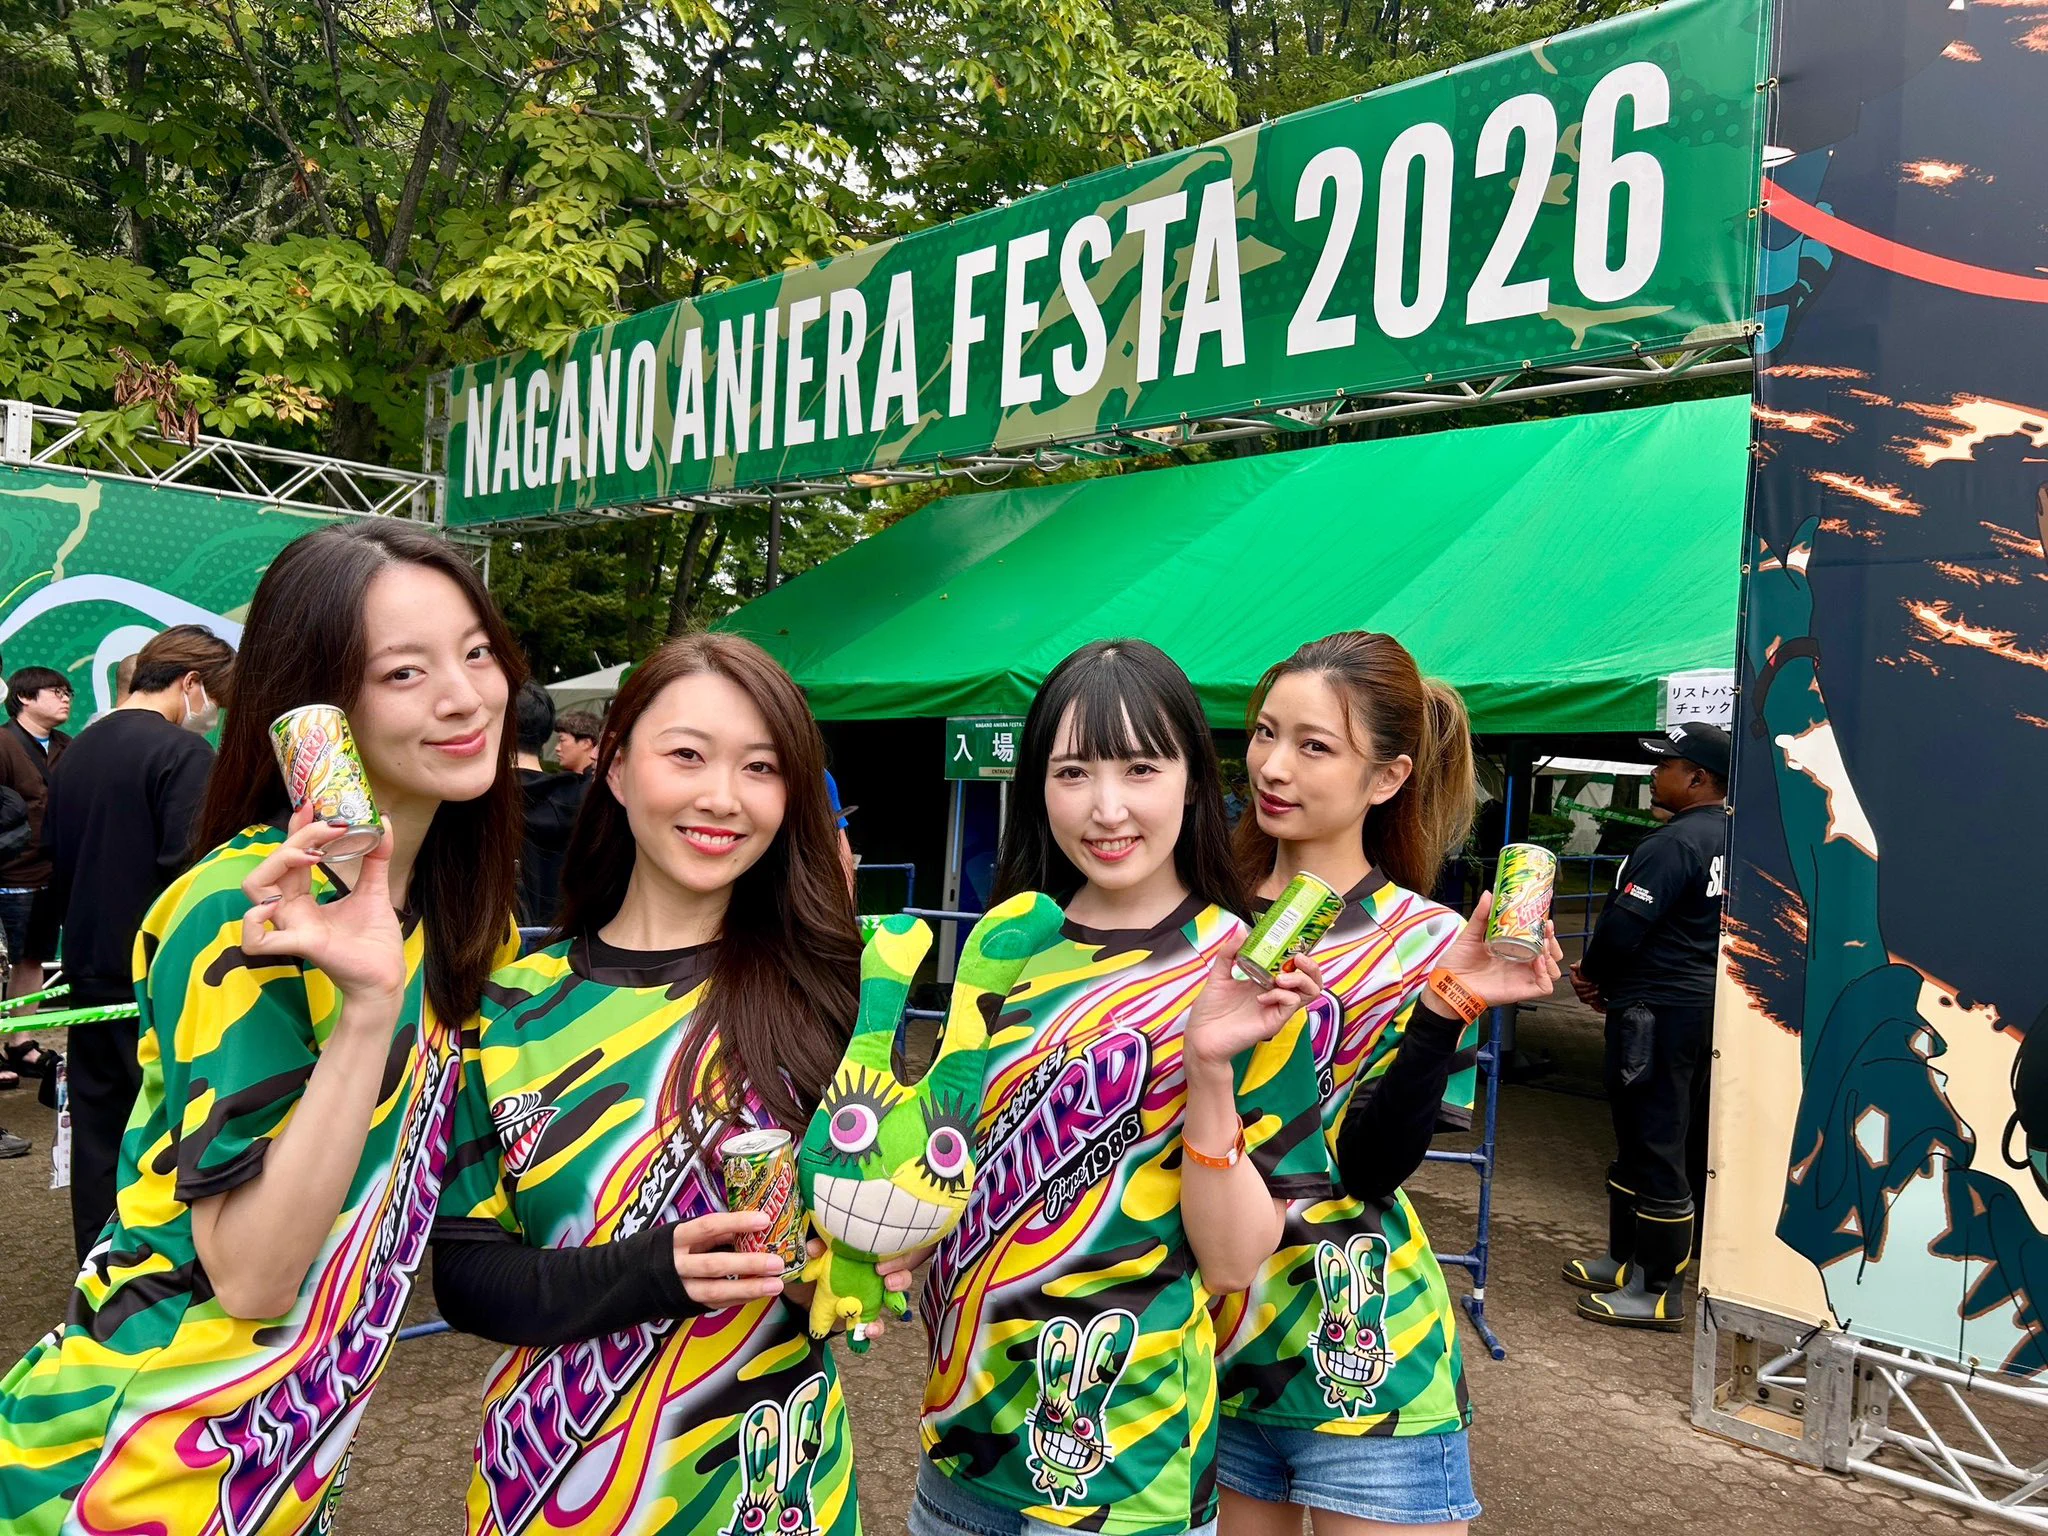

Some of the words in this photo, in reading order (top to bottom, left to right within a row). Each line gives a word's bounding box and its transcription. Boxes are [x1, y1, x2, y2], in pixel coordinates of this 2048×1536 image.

[464, 340, 656, 497] NAGANO
[670, 270, 919, 464] ANIERA
[949, 178, 1245, 417] FESTA
[1287, 61, 1670, 356] 2026
[1676, 701, 1731, 715] チェック
[1046, 1163, 1087, 1222] Since
[1084, 1112, 1142, 1183] 1986
